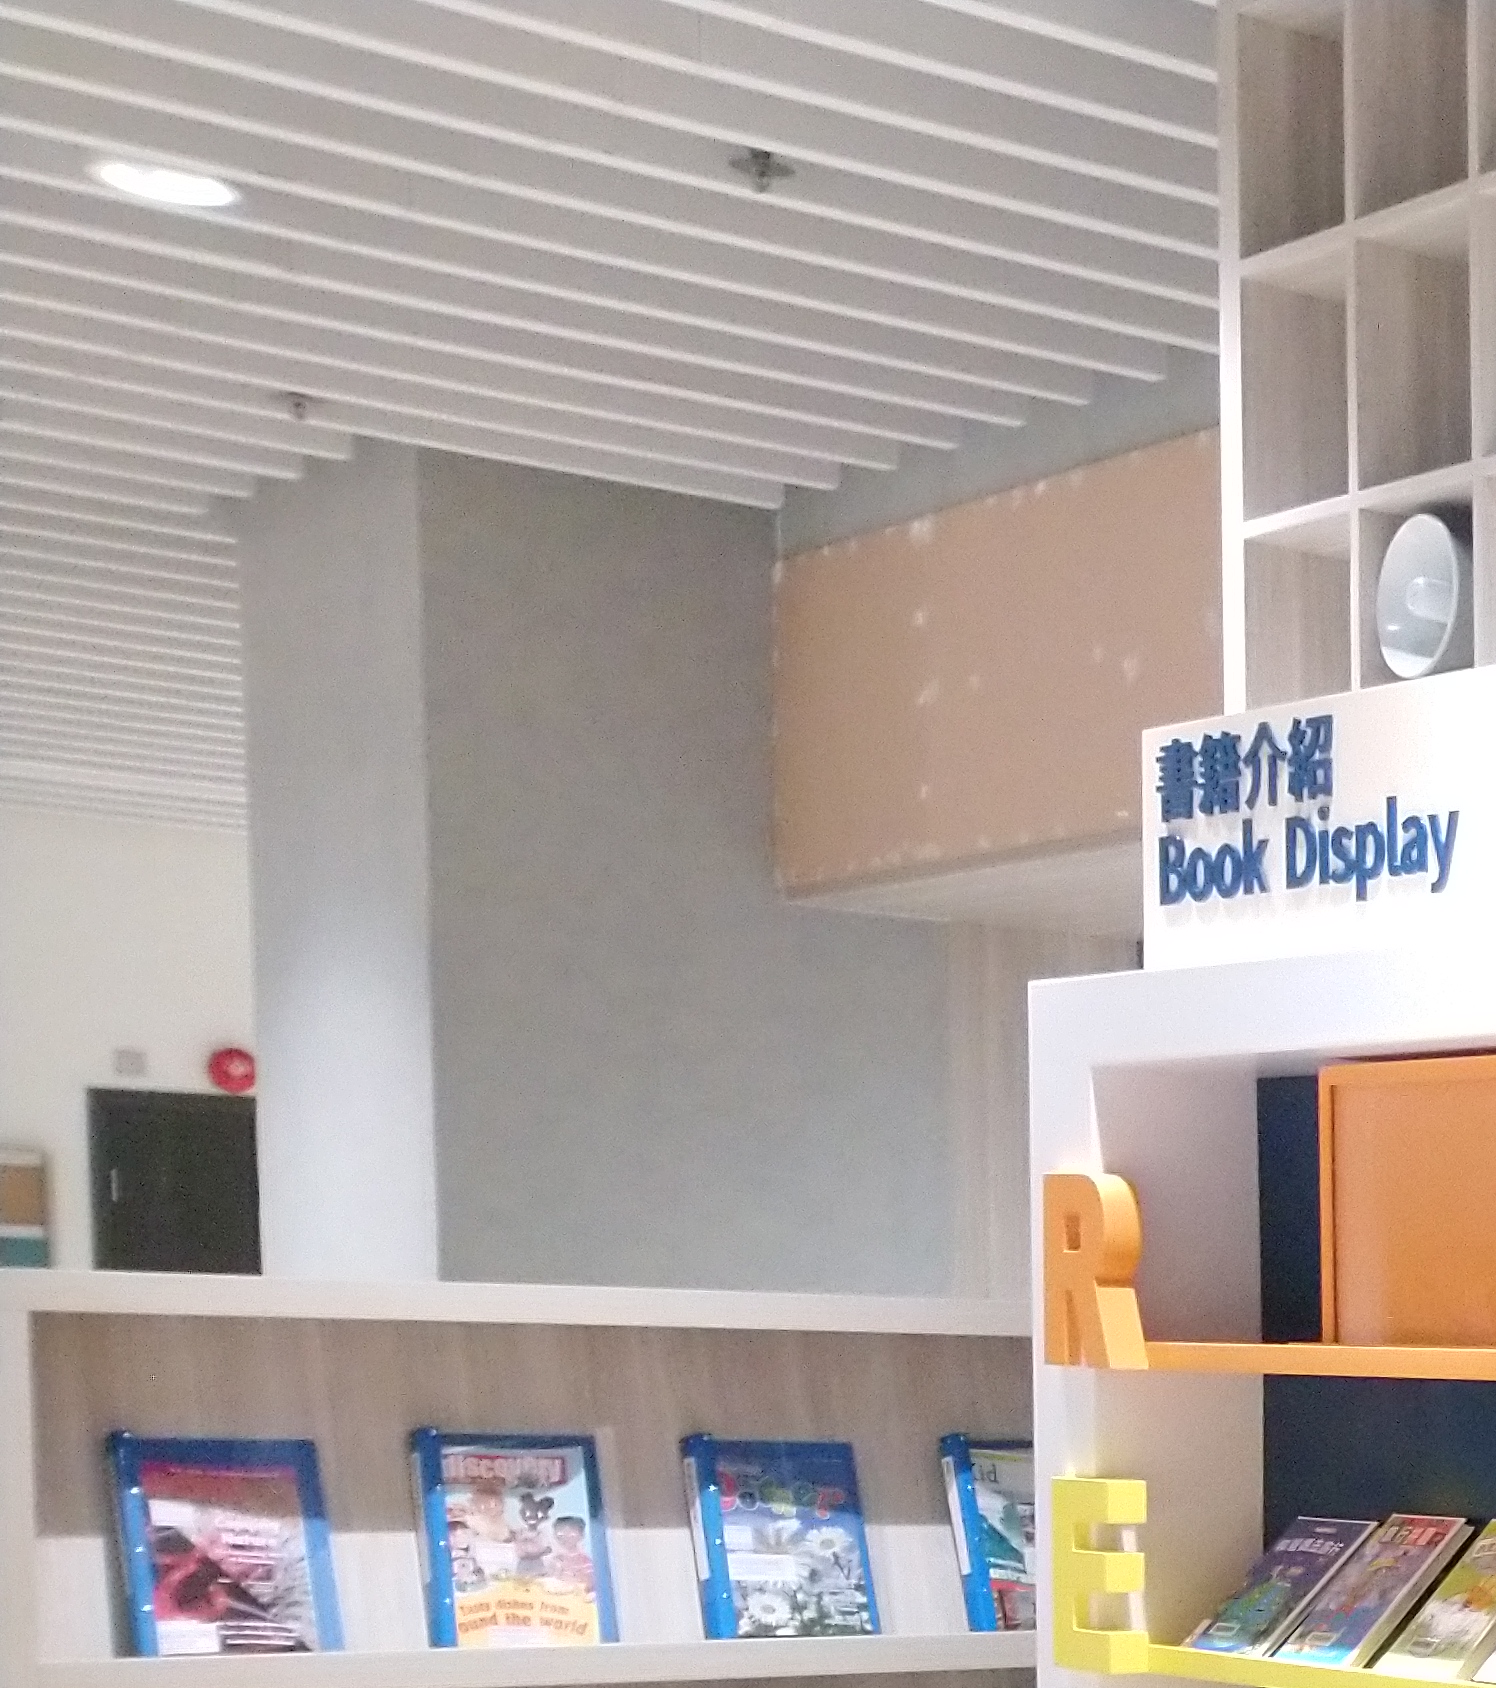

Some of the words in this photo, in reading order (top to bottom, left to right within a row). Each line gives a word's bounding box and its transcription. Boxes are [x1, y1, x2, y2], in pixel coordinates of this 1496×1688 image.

[1155, 714, 1334, 822] 書籍介紹
[1158, 818, 1270, 906] Book
[1285, 796, 1460, 902] Display
[539, 1615, 588, 1636] world
